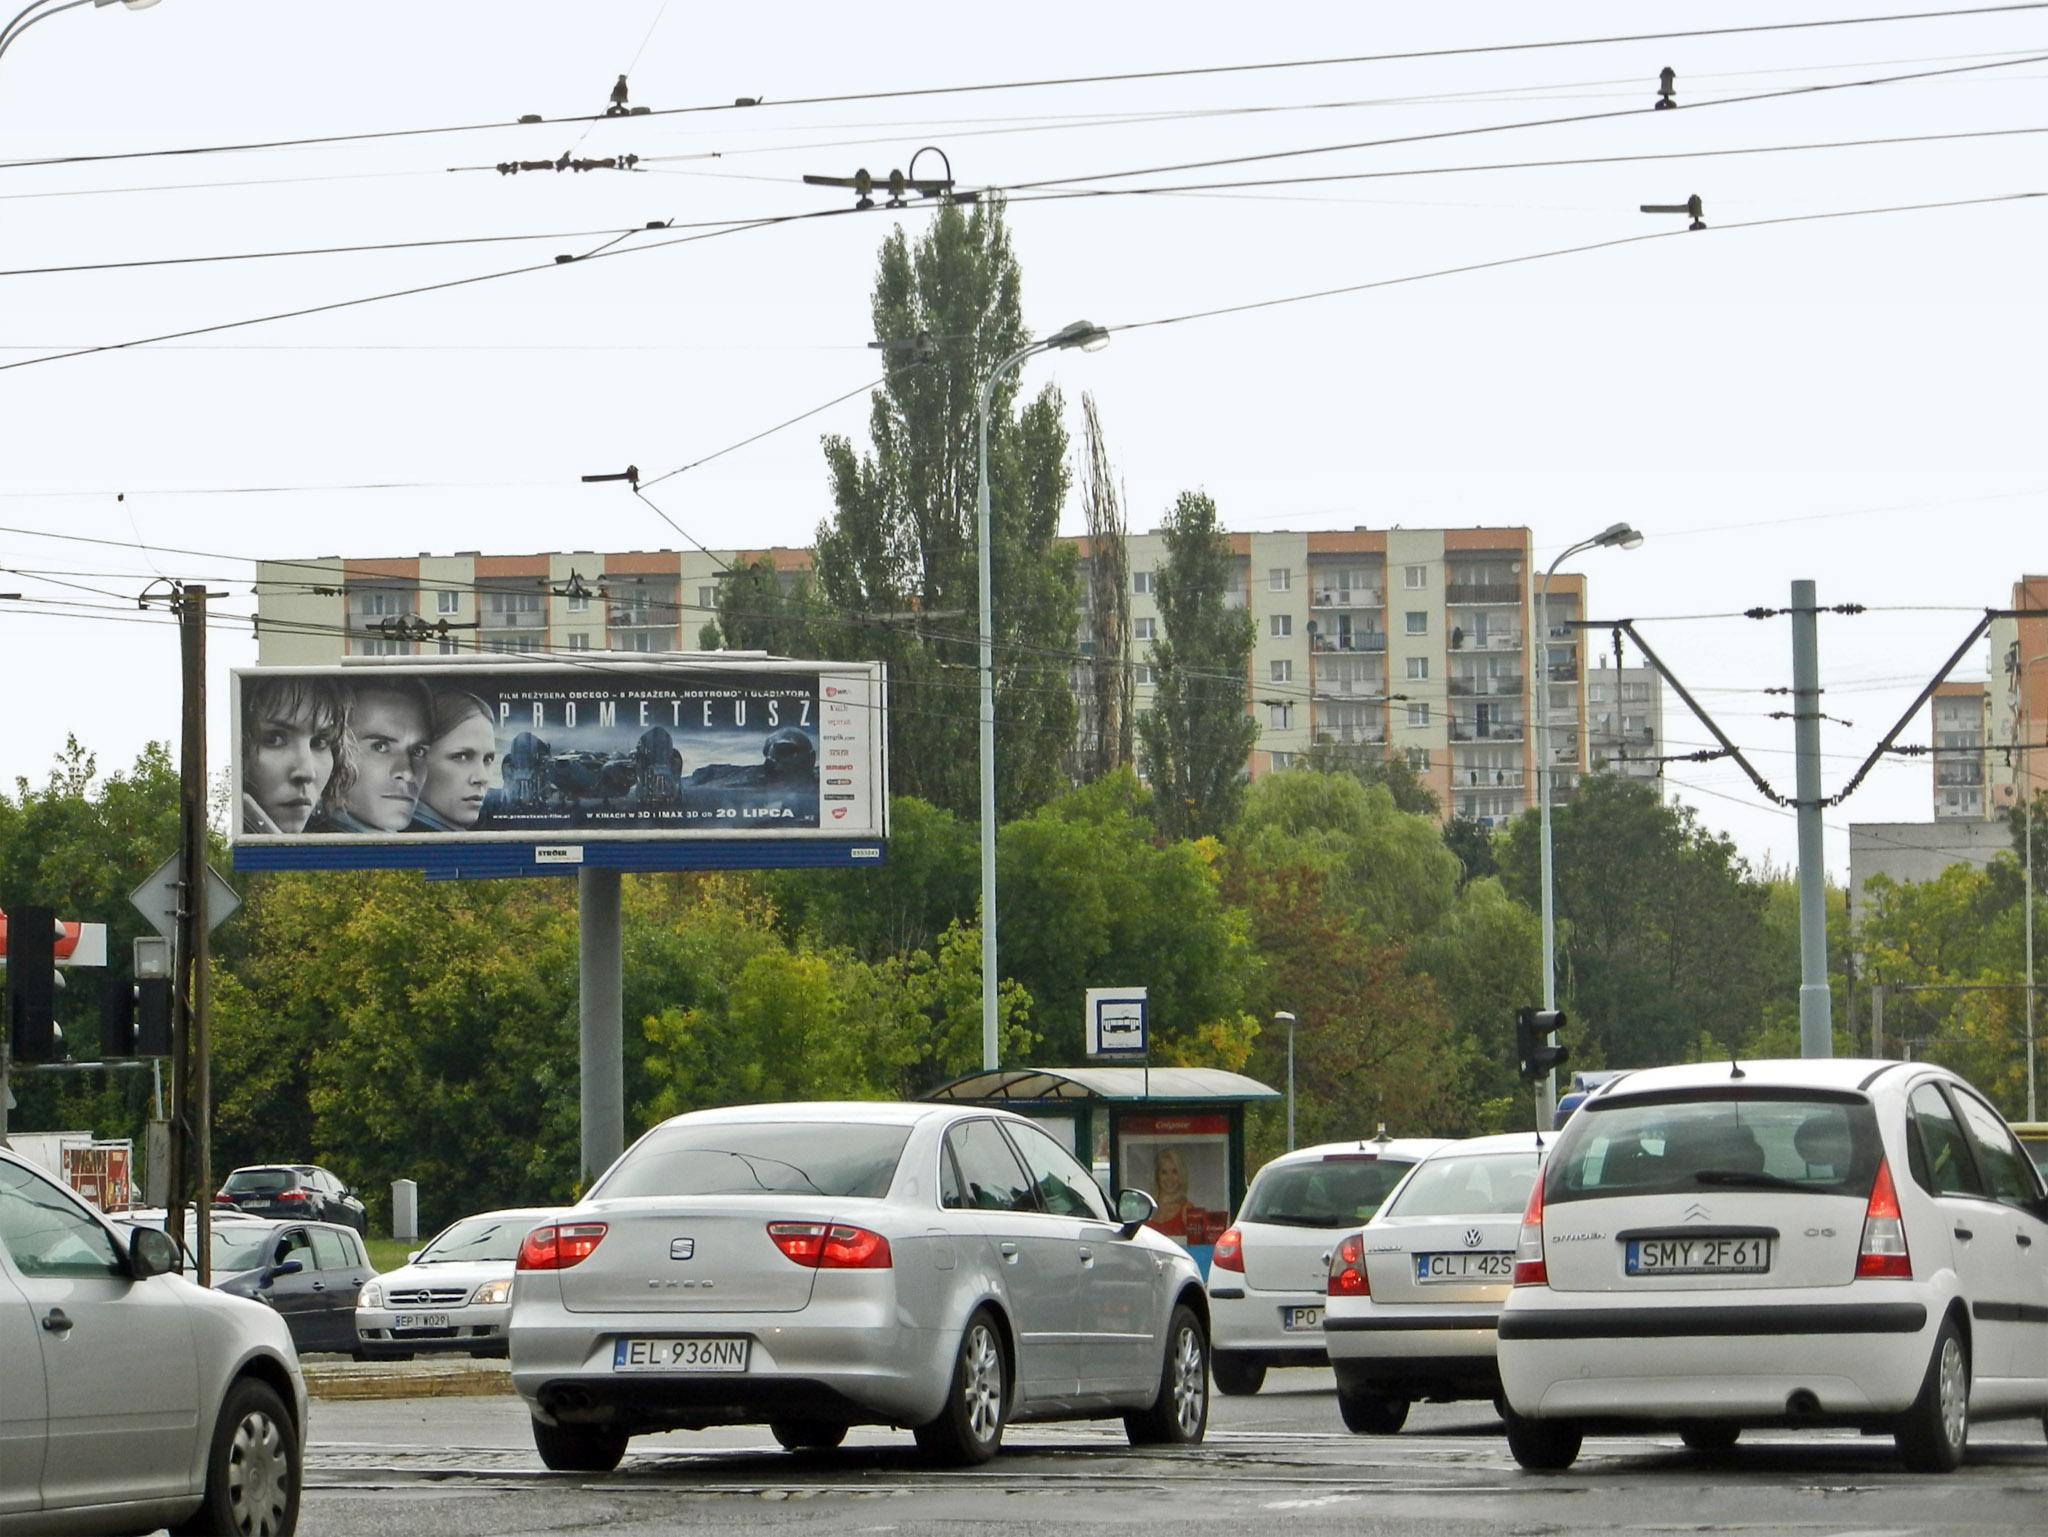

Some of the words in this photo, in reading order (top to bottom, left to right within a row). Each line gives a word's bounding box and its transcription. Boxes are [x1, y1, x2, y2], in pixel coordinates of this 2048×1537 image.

[569, 691, 609, 699] OBCEGO
[628, 689, 677, 699] PASAŻERA
[499, 700, 811, 728] PROMETEUSZ
[638, 811, 650, 819] 3D
[716, 808, 736, 818] 20
[743, 808, 795, 818] LIPCA
[1643, 1242, 1694, 1266] SMY
[1703, 1241, 1760, 1266] 2F61
[630, 1341, 661, 1365] EL
[672, 1341, 744, 1365] 936NN
